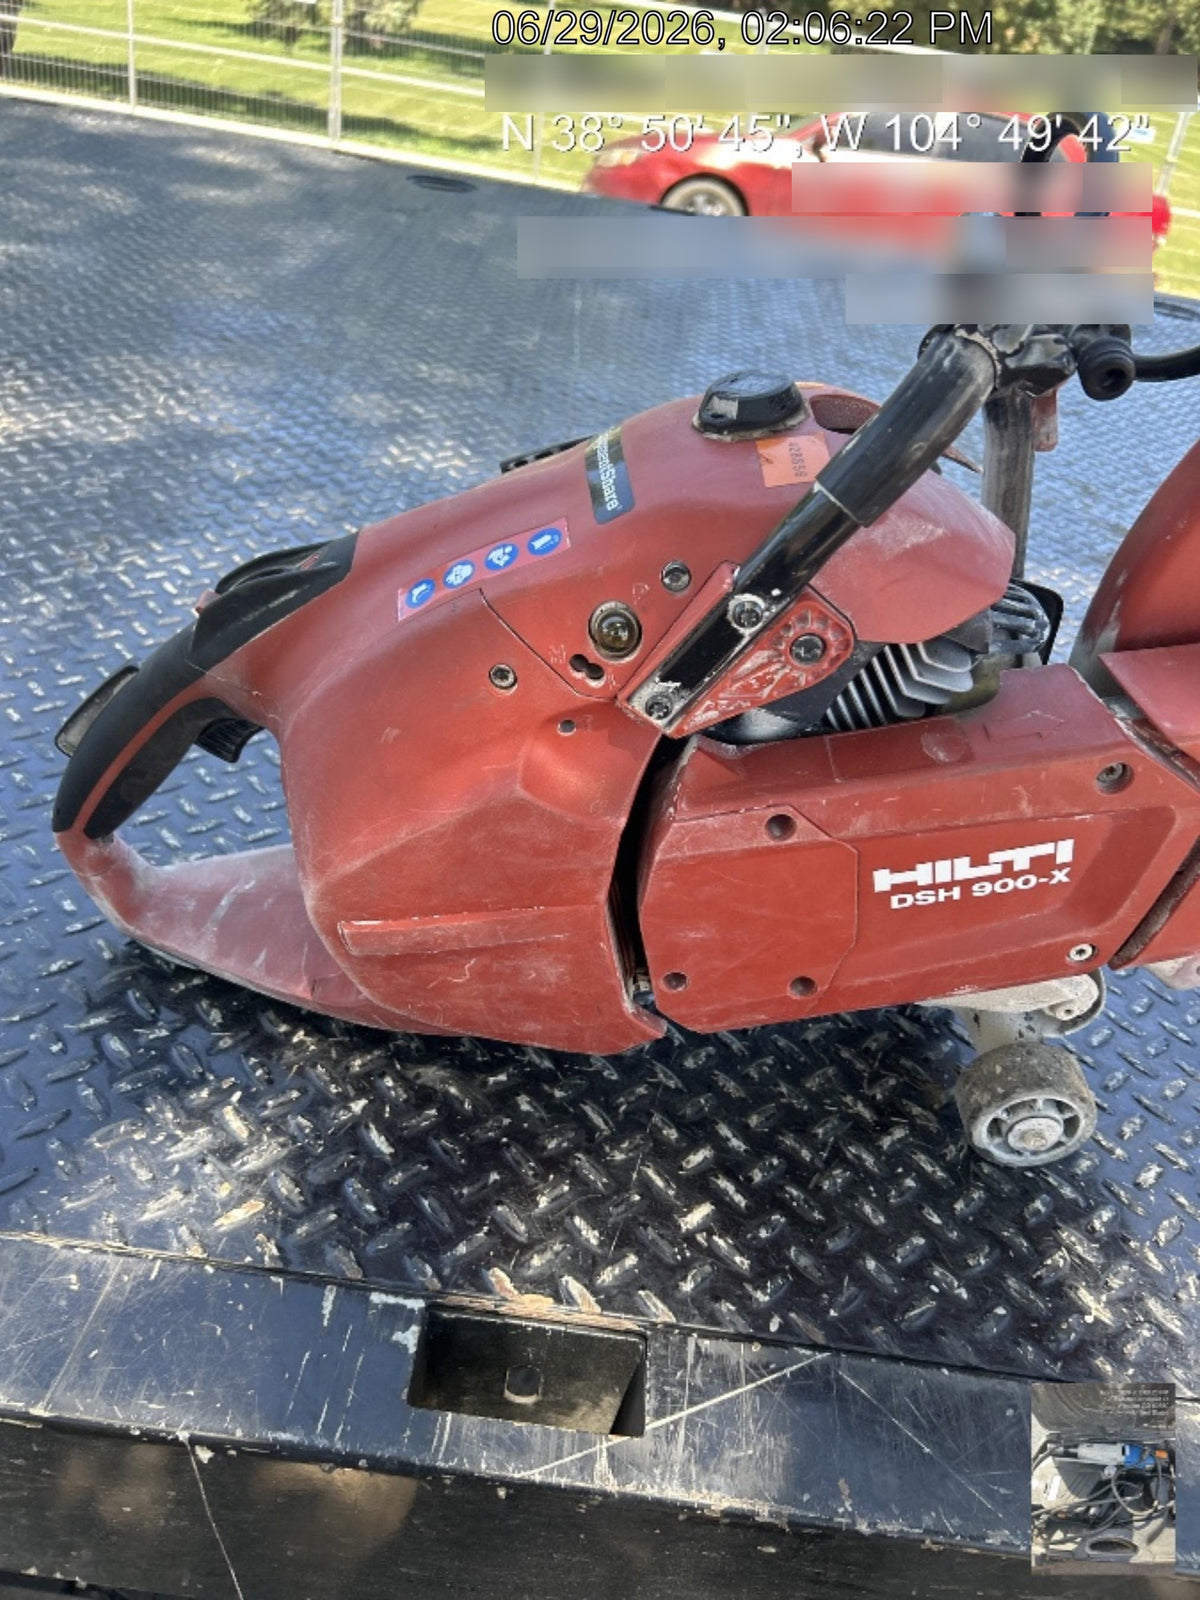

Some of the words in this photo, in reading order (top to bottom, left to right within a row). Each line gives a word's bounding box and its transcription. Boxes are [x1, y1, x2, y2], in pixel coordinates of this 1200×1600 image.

[595, 429, 620, 511] entShare
[872, 838, 1075, 893] HILTI
[890, 886, 961, 909] DSH
[971, 867, 1072, 896] 900-X
